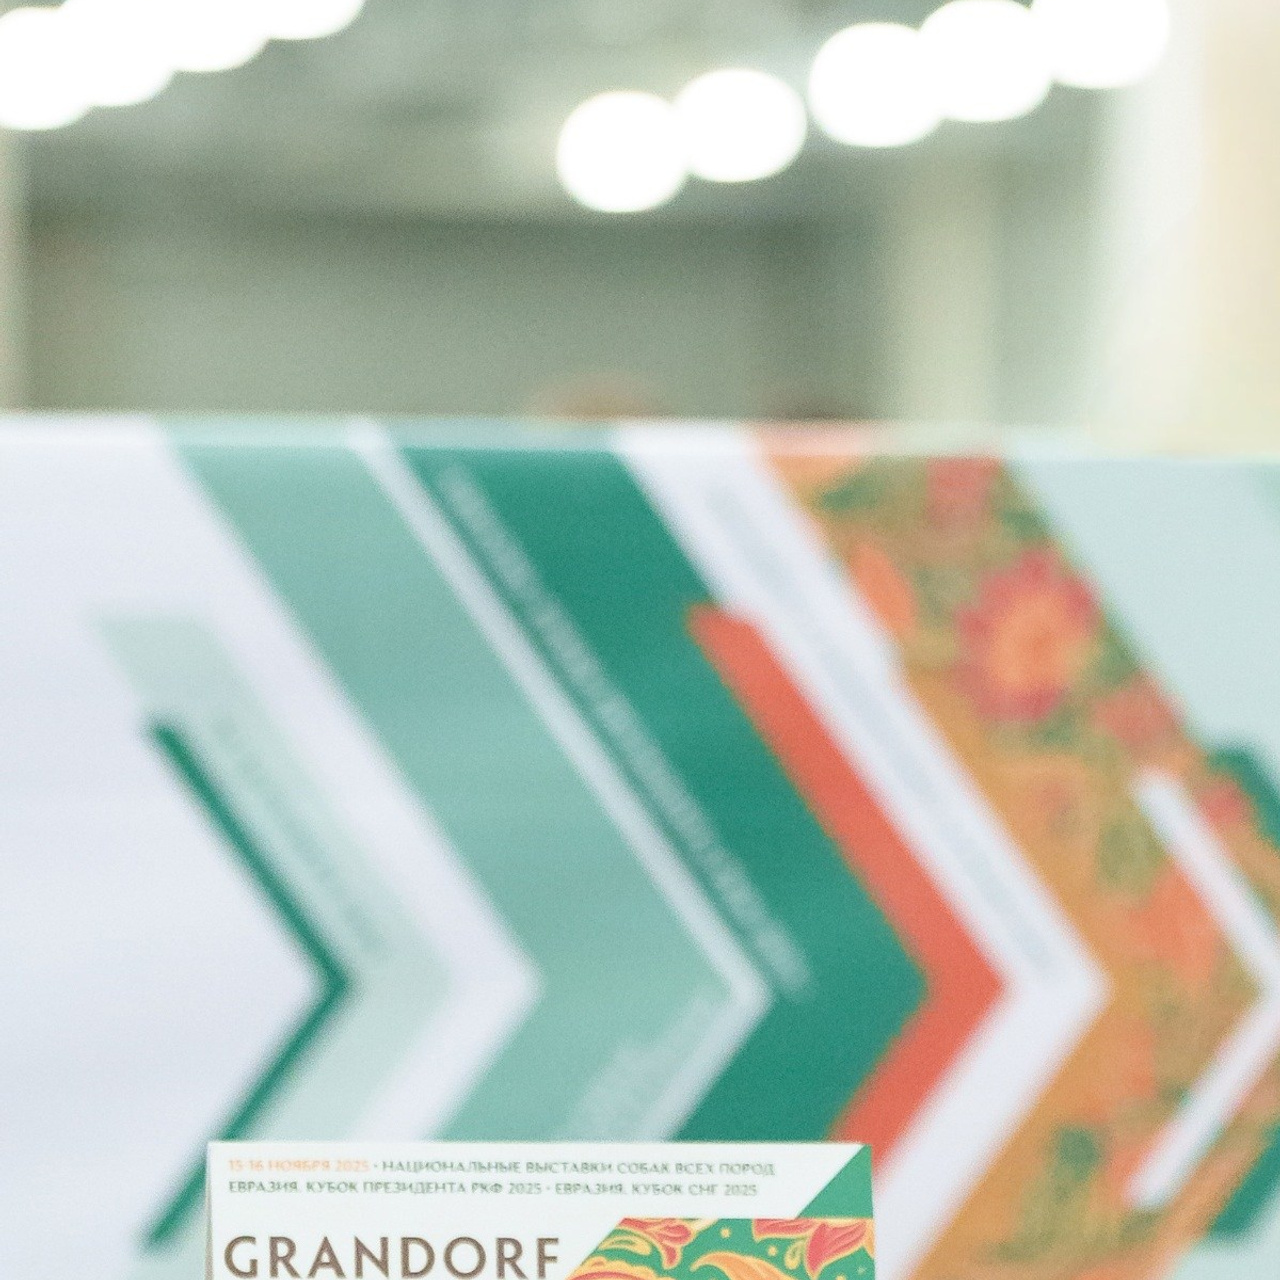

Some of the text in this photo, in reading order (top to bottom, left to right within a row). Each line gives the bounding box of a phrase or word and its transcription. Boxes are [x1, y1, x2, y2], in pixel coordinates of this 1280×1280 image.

[268, 1160, 331, 1173] НОЯБРЯ
[336, 1160, 371, 1173] 2025
[382, 1160, 521, 1174] НАЦИОНАЛЬНЫЕ
[525, 1161, 613, 1175] ВЫСТАВКИ
[616, 1162, 670, 1175] СОБАК
[674, 1163, 714, 1176] ВСЕХ
[719, 1163, 776, 1177] ПОРОД
[306, 1180, 359, 1194] КУБОК
[363, 1181, 466, 1195] ПРЕЗИДЕНТА
[470, 1181, 504, 1195] РКФ
[507, 1182, 543, 1195] 2025
[631, 1183, 683, 1196] КУБОК
[687, 1183, 719, 1197] СНГ
[724, 1184, 759, 1197] 2025
[224, 1234, 560, 1280] GRANDORF
